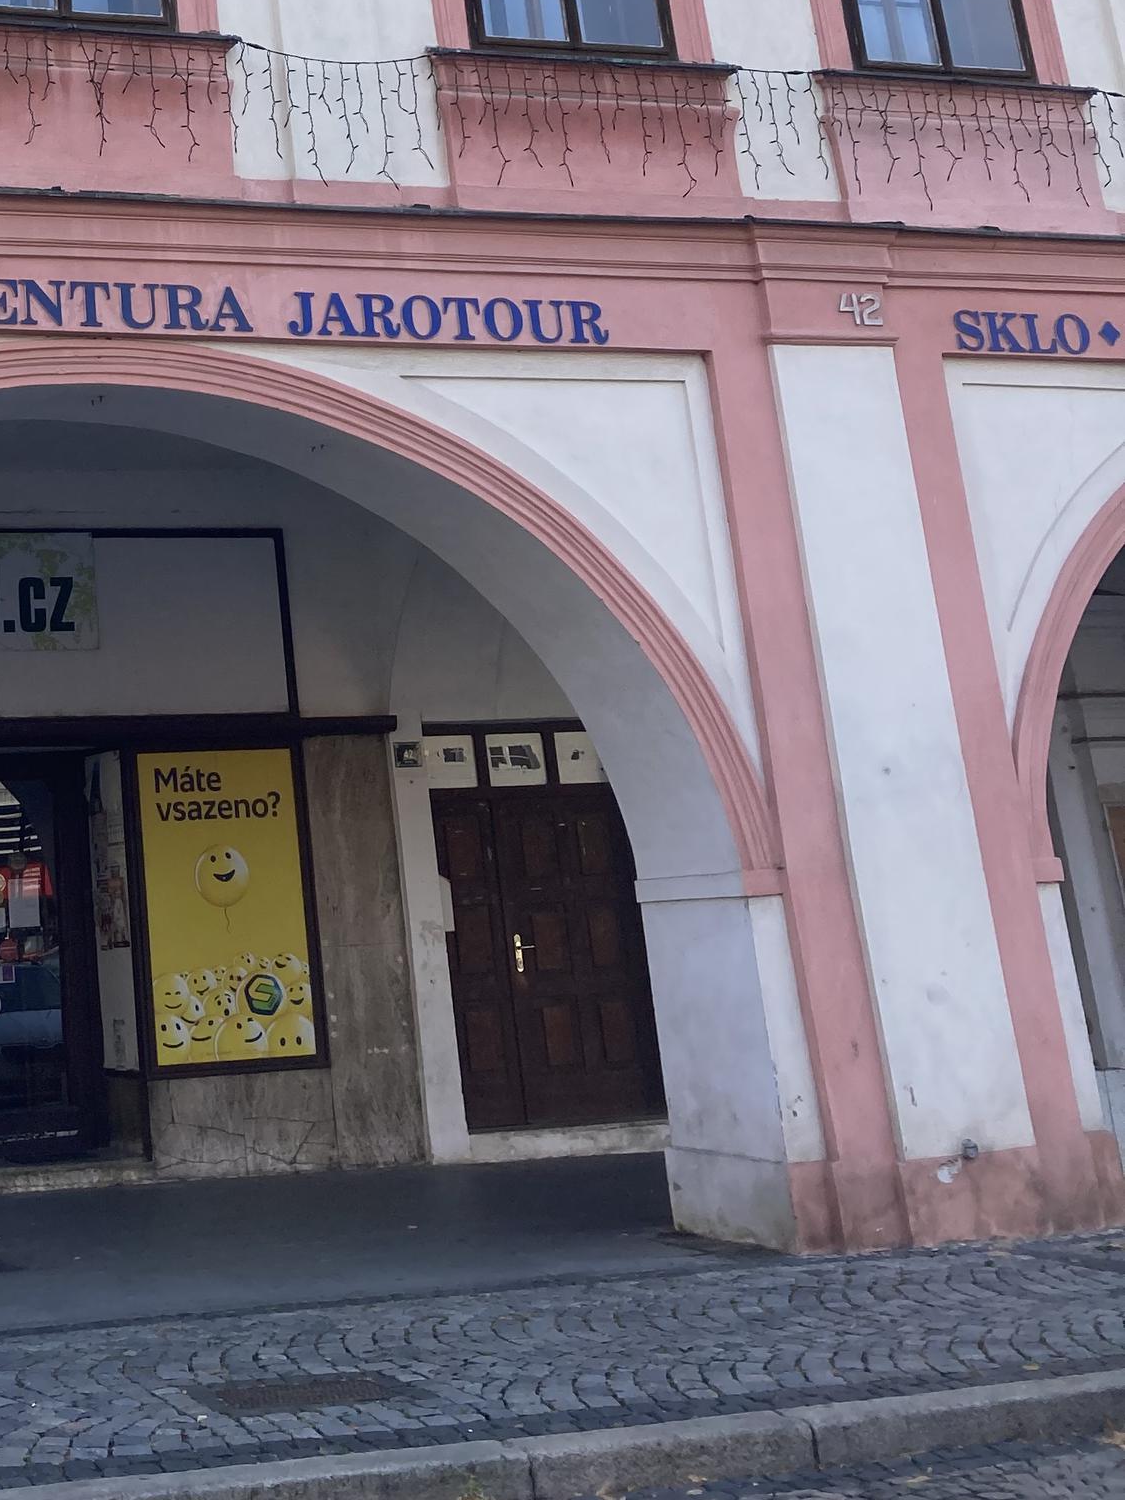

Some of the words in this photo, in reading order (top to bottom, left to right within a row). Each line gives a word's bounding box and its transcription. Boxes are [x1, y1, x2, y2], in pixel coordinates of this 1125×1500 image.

[288, 291, 610, 346] JAROTOUR
[840, 293, 884, 327] 42
[953, 309, 1091, 355] SKLO
[154, 766, 221, 793] Máte
[155, 791, 280, 821] vsazeno?
